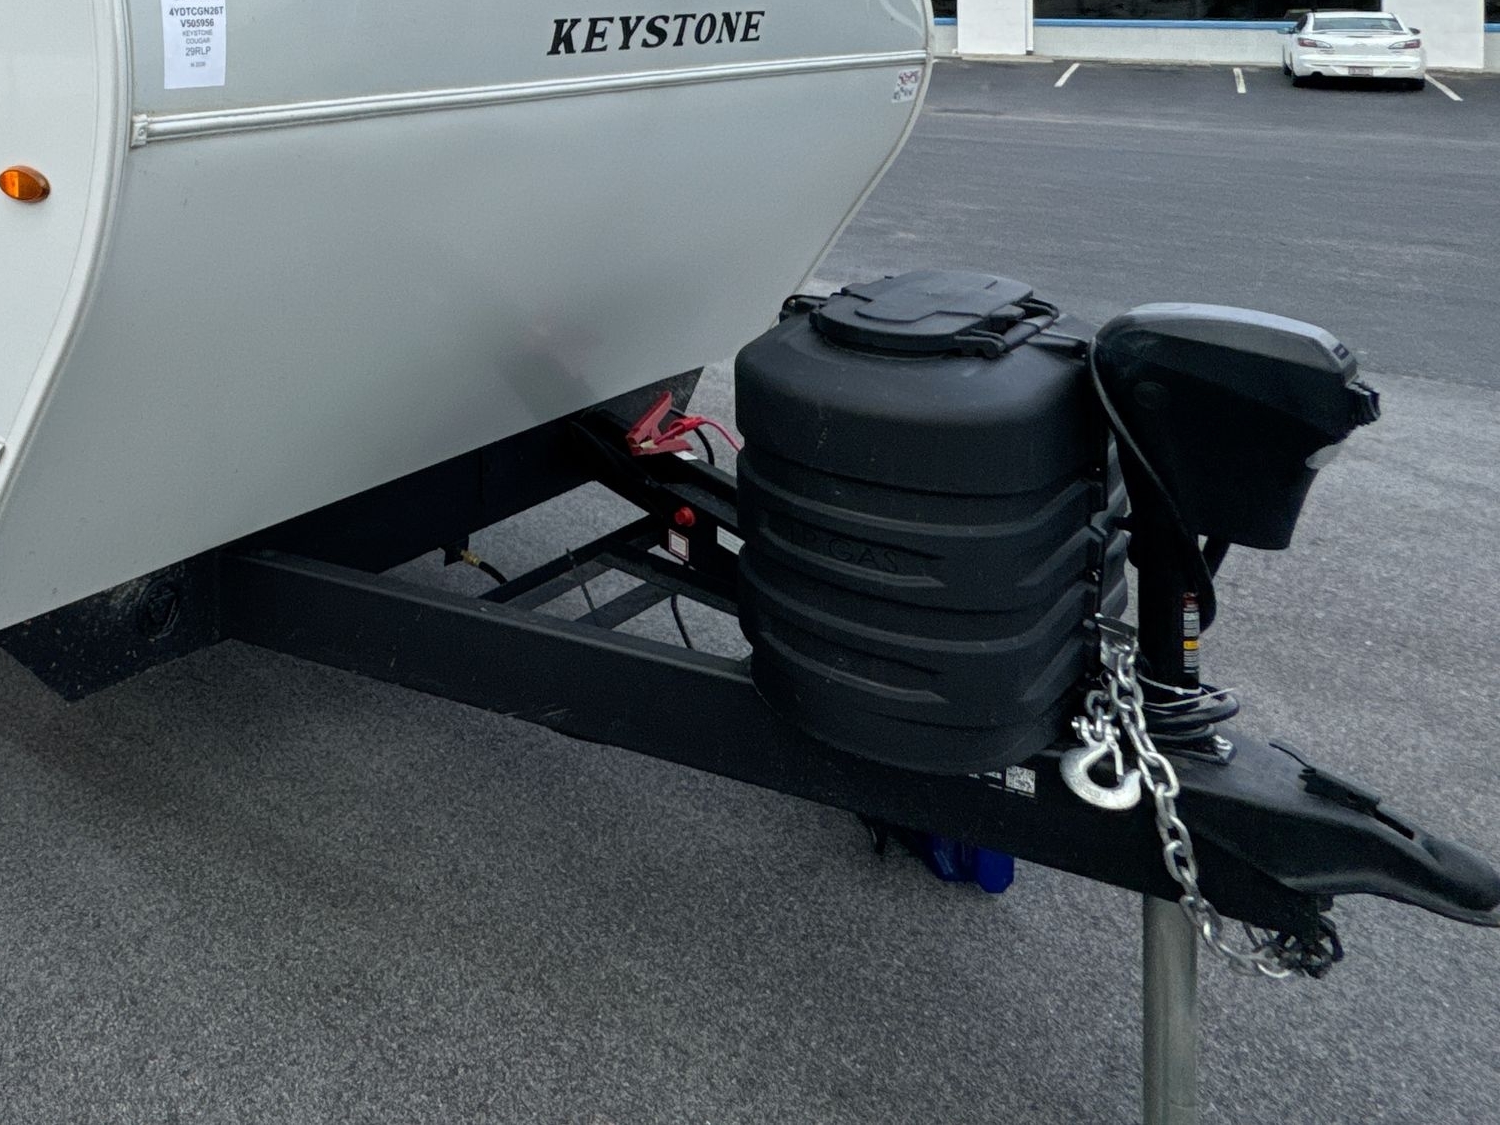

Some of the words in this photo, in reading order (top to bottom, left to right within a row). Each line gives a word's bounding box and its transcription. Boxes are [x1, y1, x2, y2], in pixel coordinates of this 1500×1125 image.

[169, 6, 224, 17] 4YDTCGN26T
[180, 18, 215, 28] V505956
[546, 10, 766, 57] KEYSTONE
[185, 45, 212, 57] 29RLP
